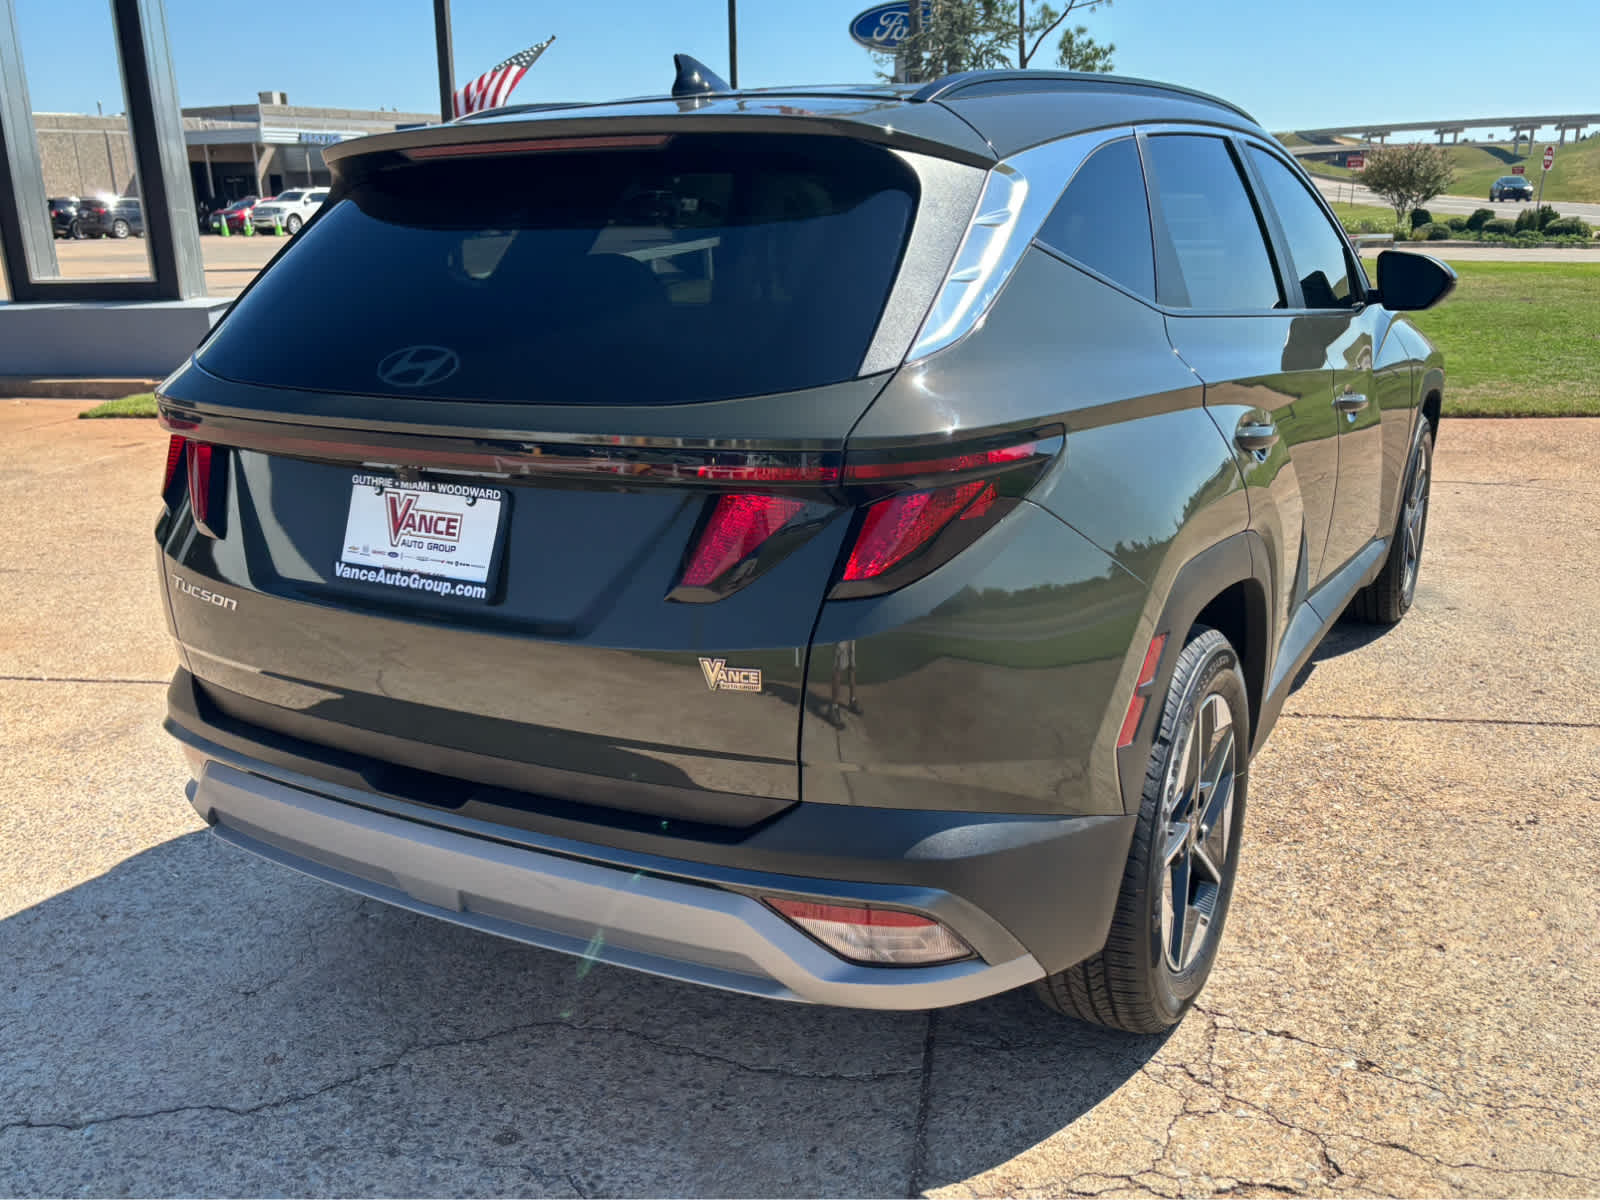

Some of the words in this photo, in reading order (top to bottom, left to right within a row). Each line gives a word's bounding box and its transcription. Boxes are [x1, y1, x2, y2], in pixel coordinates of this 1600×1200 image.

[873, 11, 926, 40] Fo
[352, 474, 393, 488] GUTHRIE
[400, 480, 430, 492] MIAMI
[437, 483, 501, 500] WOODWARD
[400, 538, 424, 549] AUTO
[426, 542, 457, 553] GROUP
[335, 561, 486, 599] VanceAutoGroup.com
